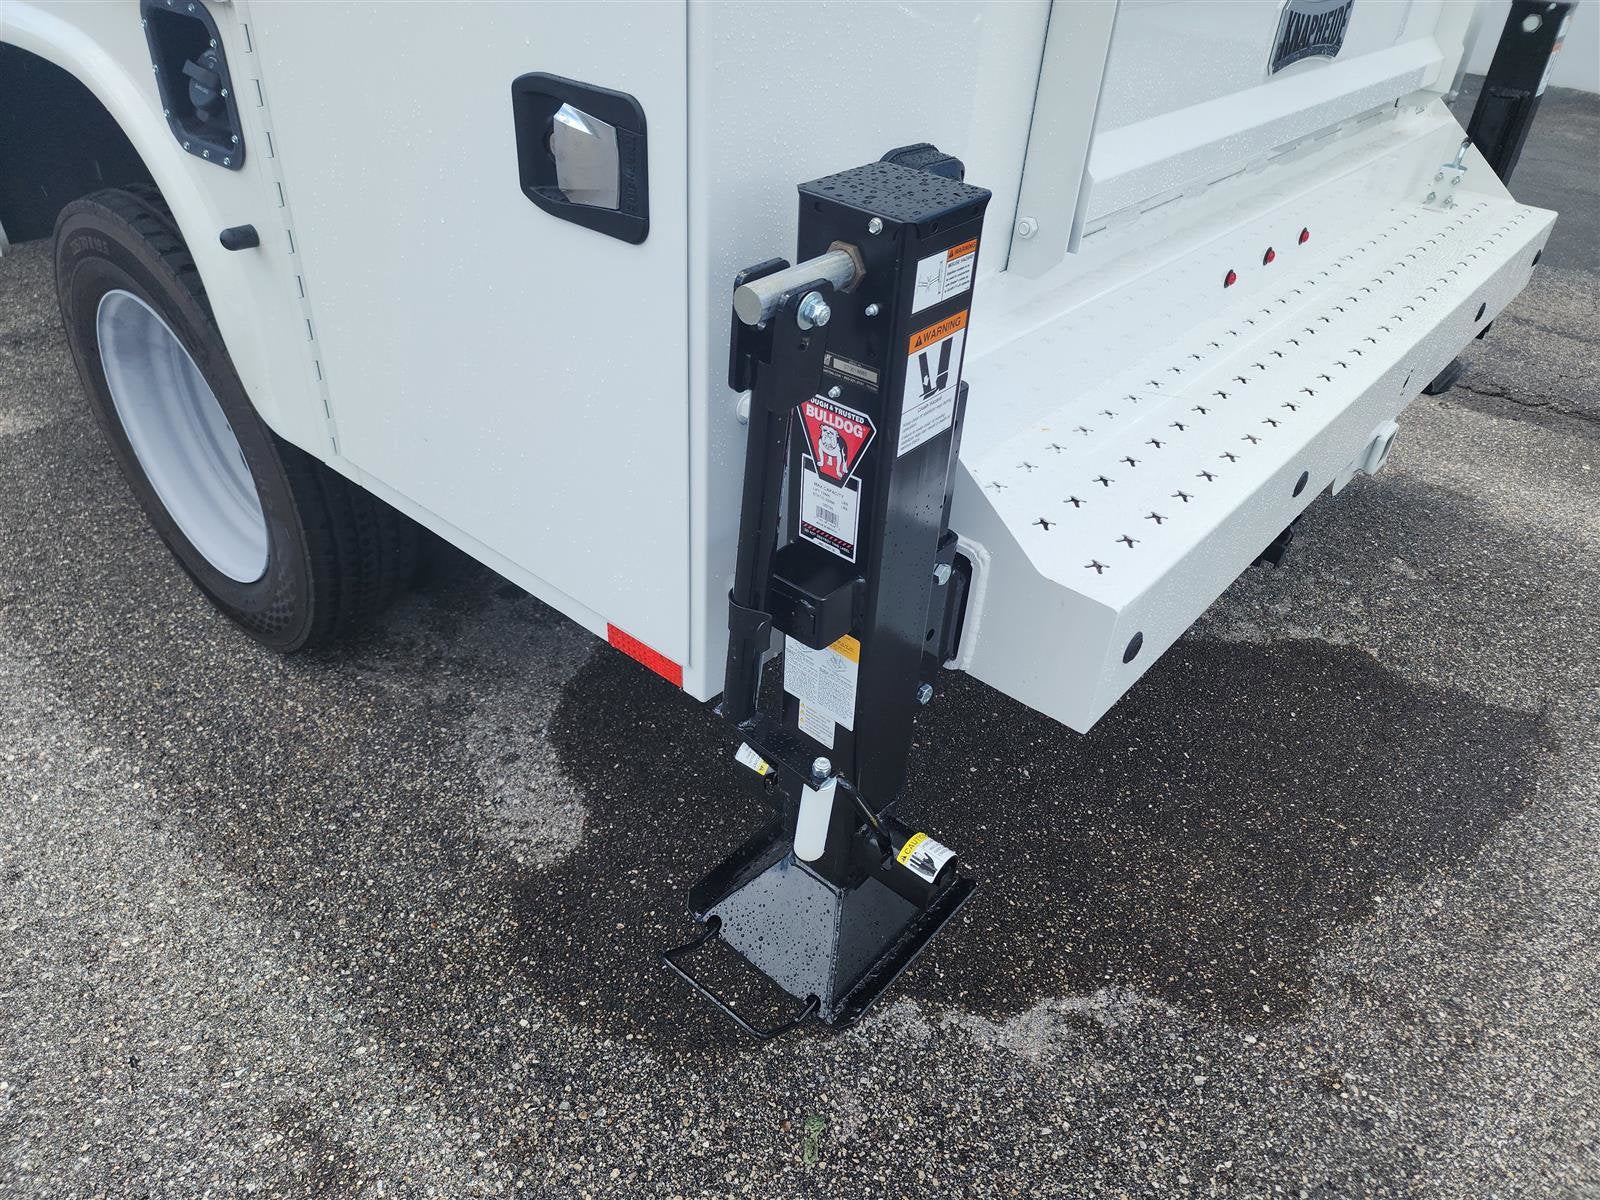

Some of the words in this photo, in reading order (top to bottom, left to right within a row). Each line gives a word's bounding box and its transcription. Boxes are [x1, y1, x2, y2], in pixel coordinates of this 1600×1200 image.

[1277, 0, 1353, 60] KNAPHEIDE
[923, 316, 961, 342] WARNING
[806, 403, 863, 439] BULLDOG
[809, 396, 828, 410] OUGH
[829, 404, 835, 412] &
[834, 407, 865, 424] TRUSTED
